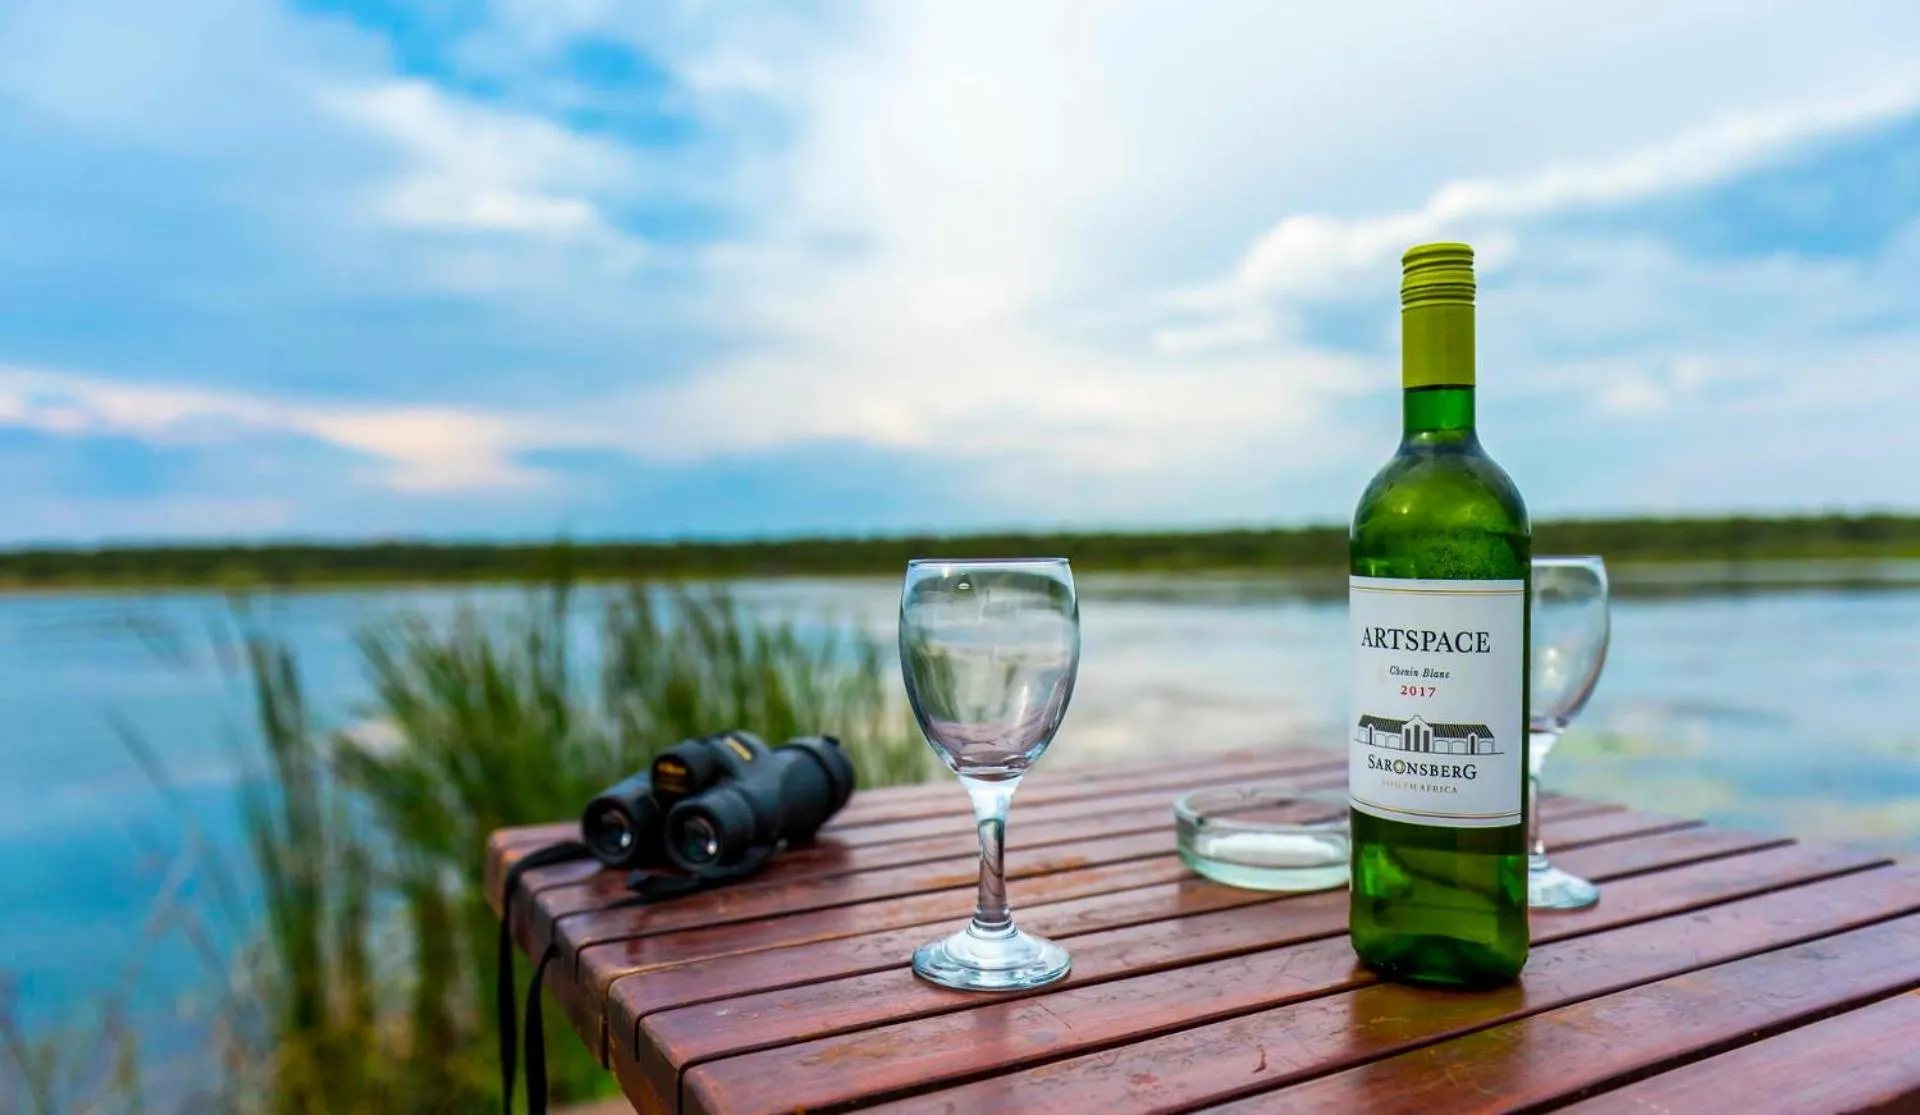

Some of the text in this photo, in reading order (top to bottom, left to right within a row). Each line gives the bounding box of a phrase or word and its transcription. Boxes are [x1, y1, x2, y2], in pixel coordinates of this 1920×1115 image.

[1361, 626, 1491, 654] ARTSPACE
[1389, 665, 1450, 679] Chenin Blanc
[1400, 685, 1436, 698] 2017
[1419, 783, 1458, 794] AFRICA
